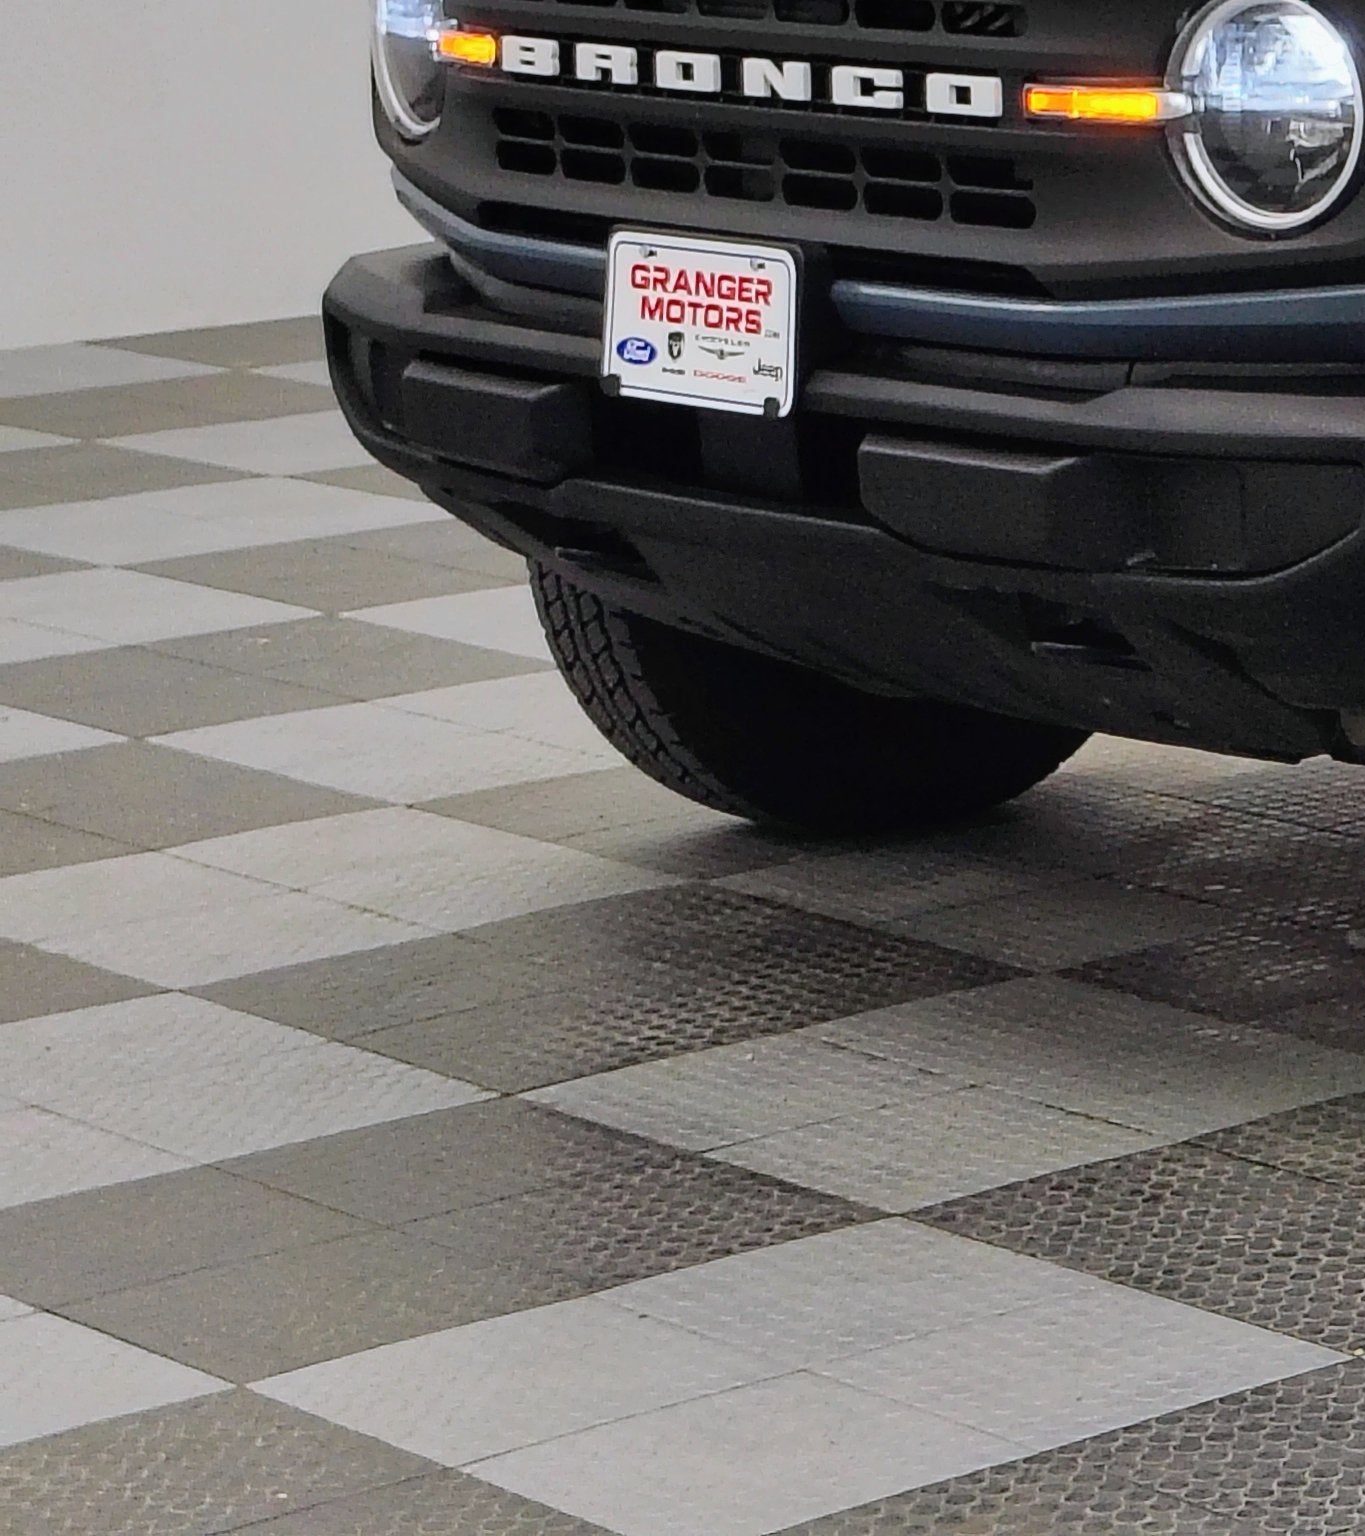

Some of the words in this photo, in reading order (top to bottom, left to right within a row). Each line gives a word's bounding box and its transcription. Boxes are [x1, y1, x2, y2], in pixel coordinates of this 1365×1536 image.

[501, 35, 1003, 118] BRONCO
[631, 263, 774, 307] GRANGER
[640, 295, 763, 335] MOTORS
[752, 357, 784, 382] Jeep
